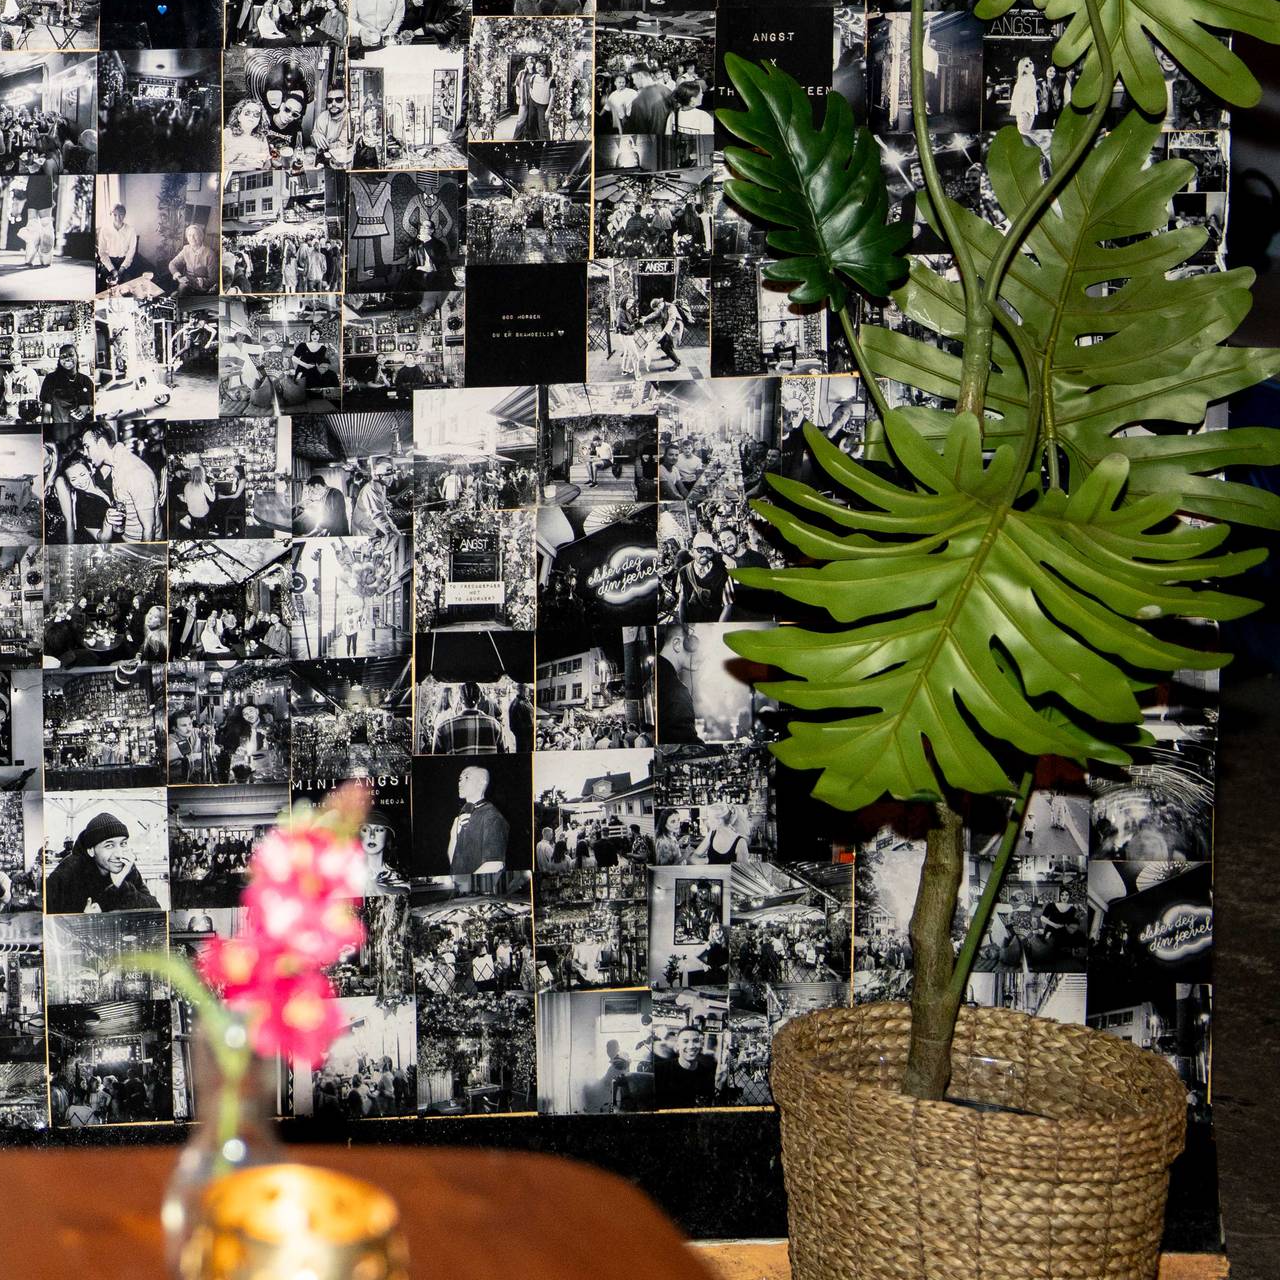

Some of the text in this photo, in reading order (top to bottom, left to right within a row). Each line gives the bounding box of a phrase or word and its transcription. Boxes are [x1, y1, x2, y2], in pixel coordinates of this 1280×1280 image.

[752, 31, 796, 43] ANGST
[459, 538, 489, 550] ANGST
[291, 778, 337, 791] MINI
